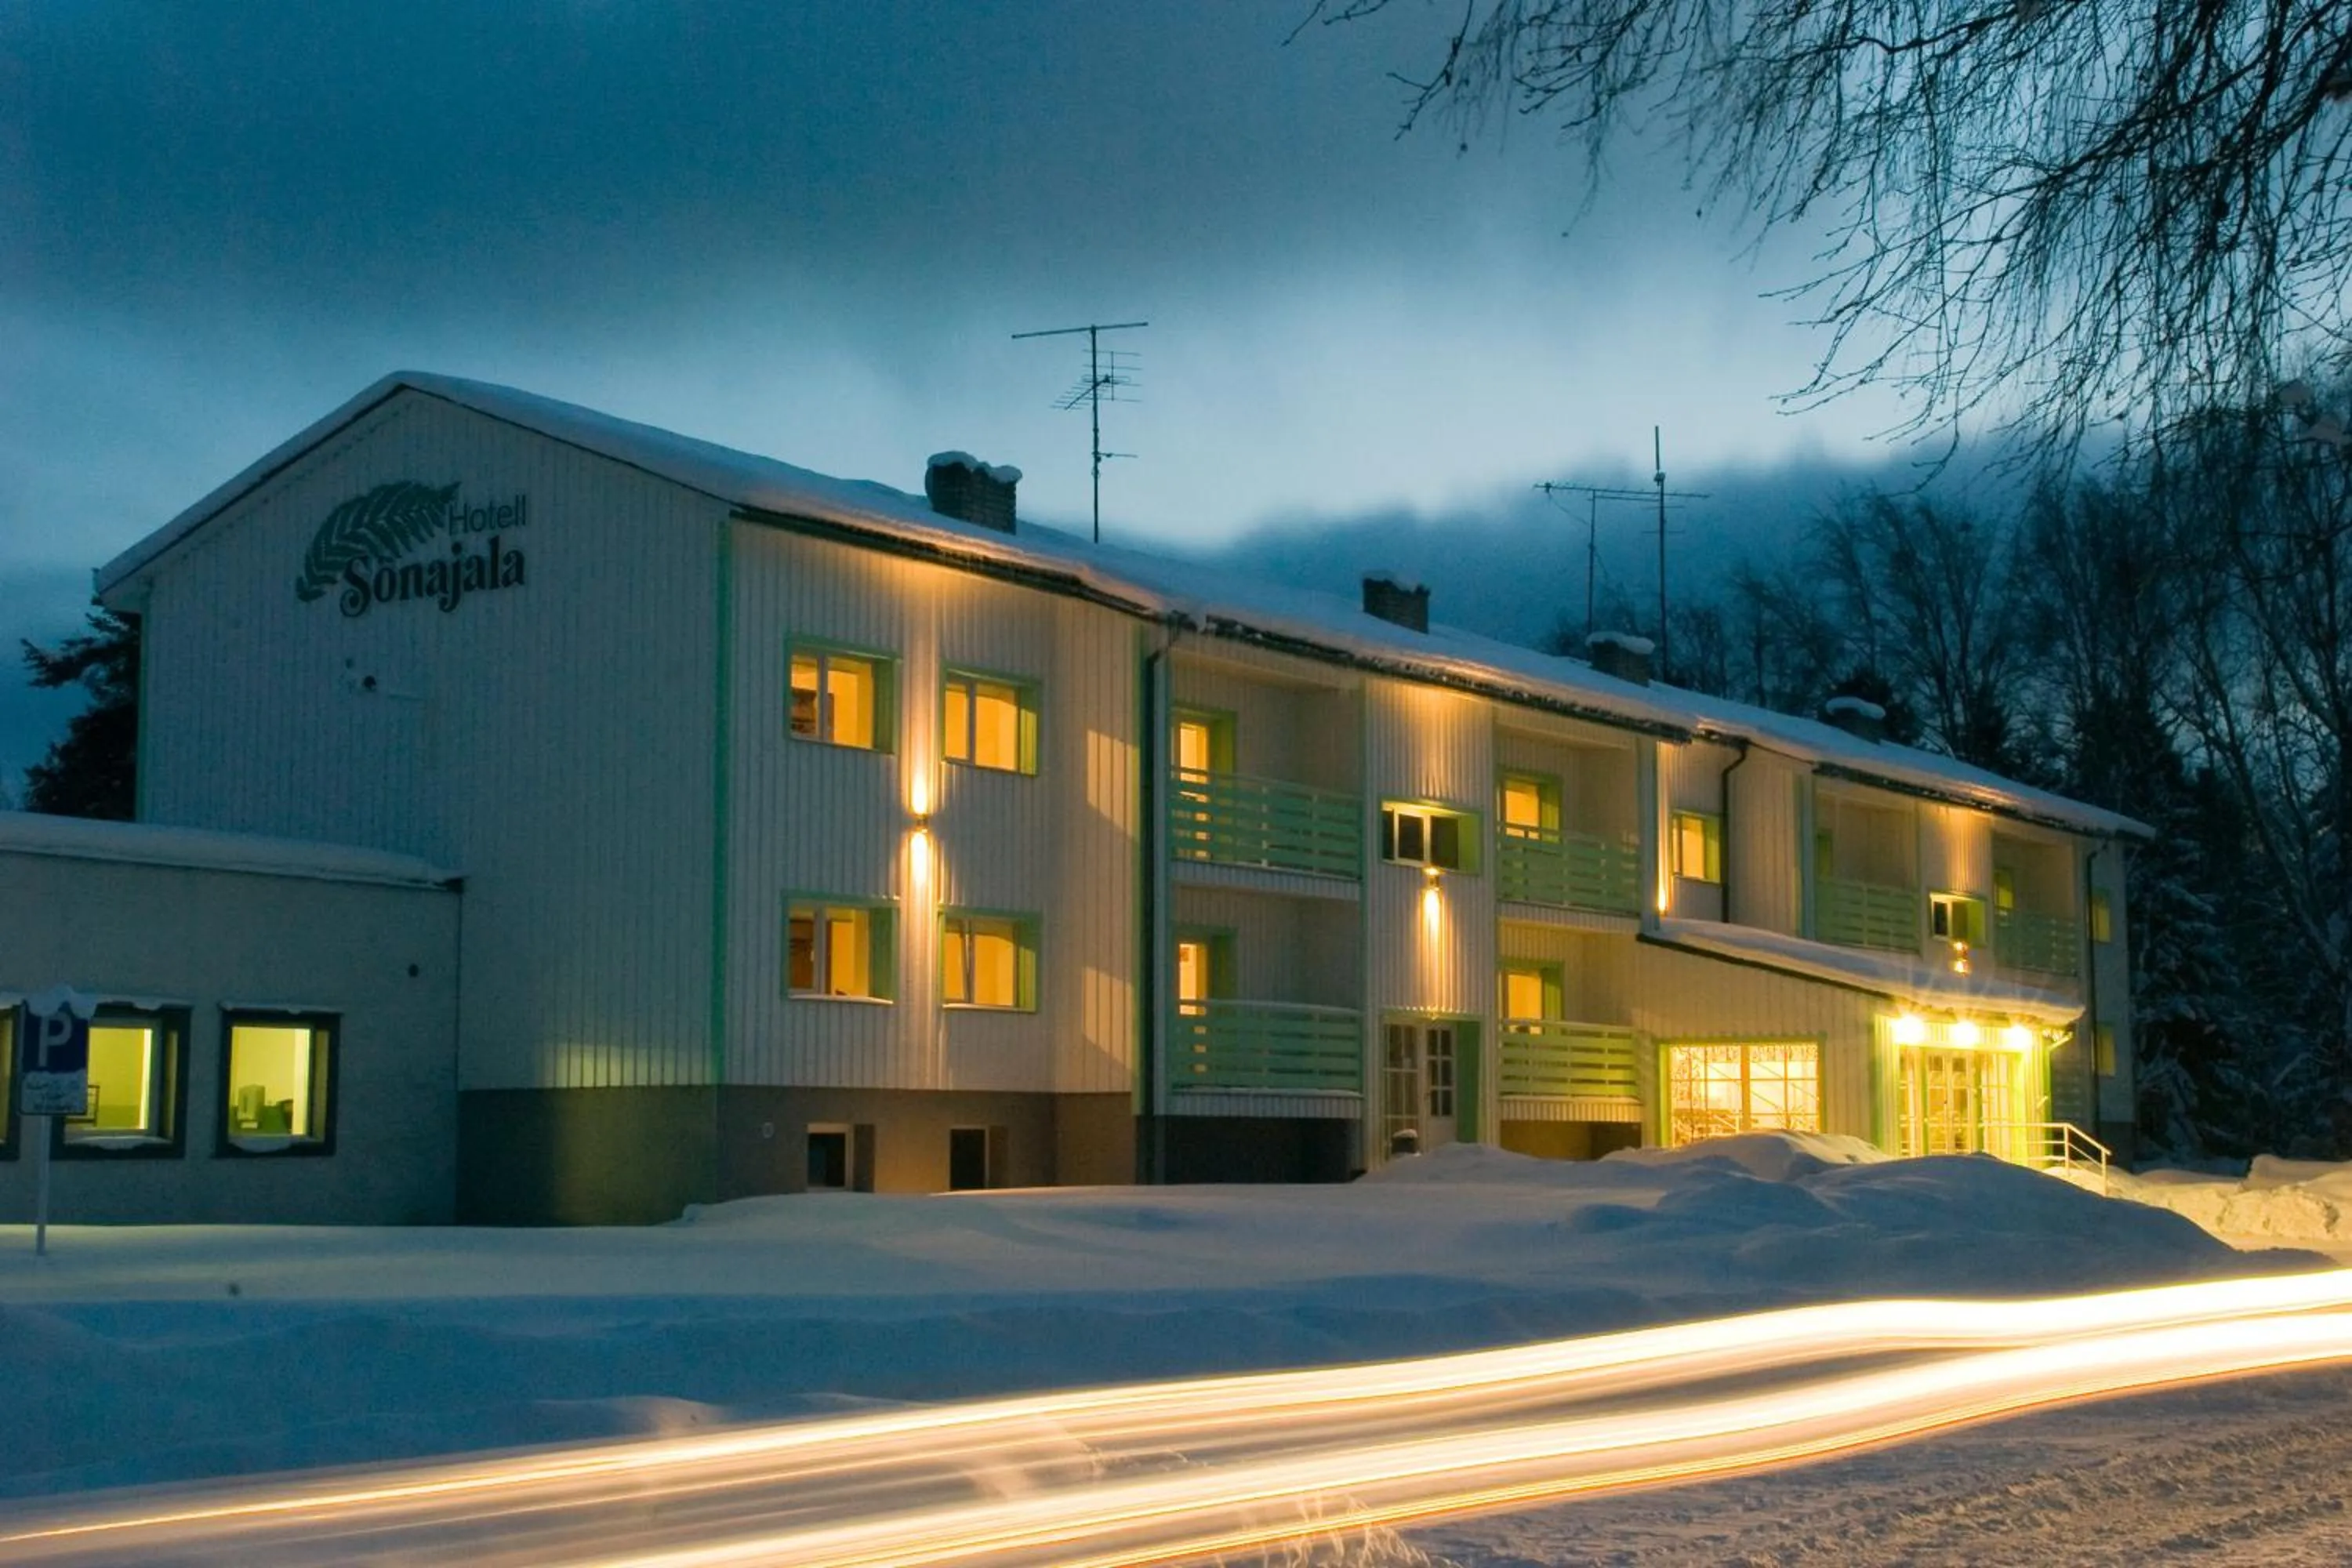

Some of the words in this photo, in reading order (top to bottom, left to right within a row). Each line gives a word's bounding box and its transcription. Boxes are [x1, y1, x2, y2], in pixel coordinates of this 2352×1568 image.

[448, 494, 527, 536] Hotell
[339, 535, 525, 618] Sõnajala
[38, 1011, 72, 1067] P
